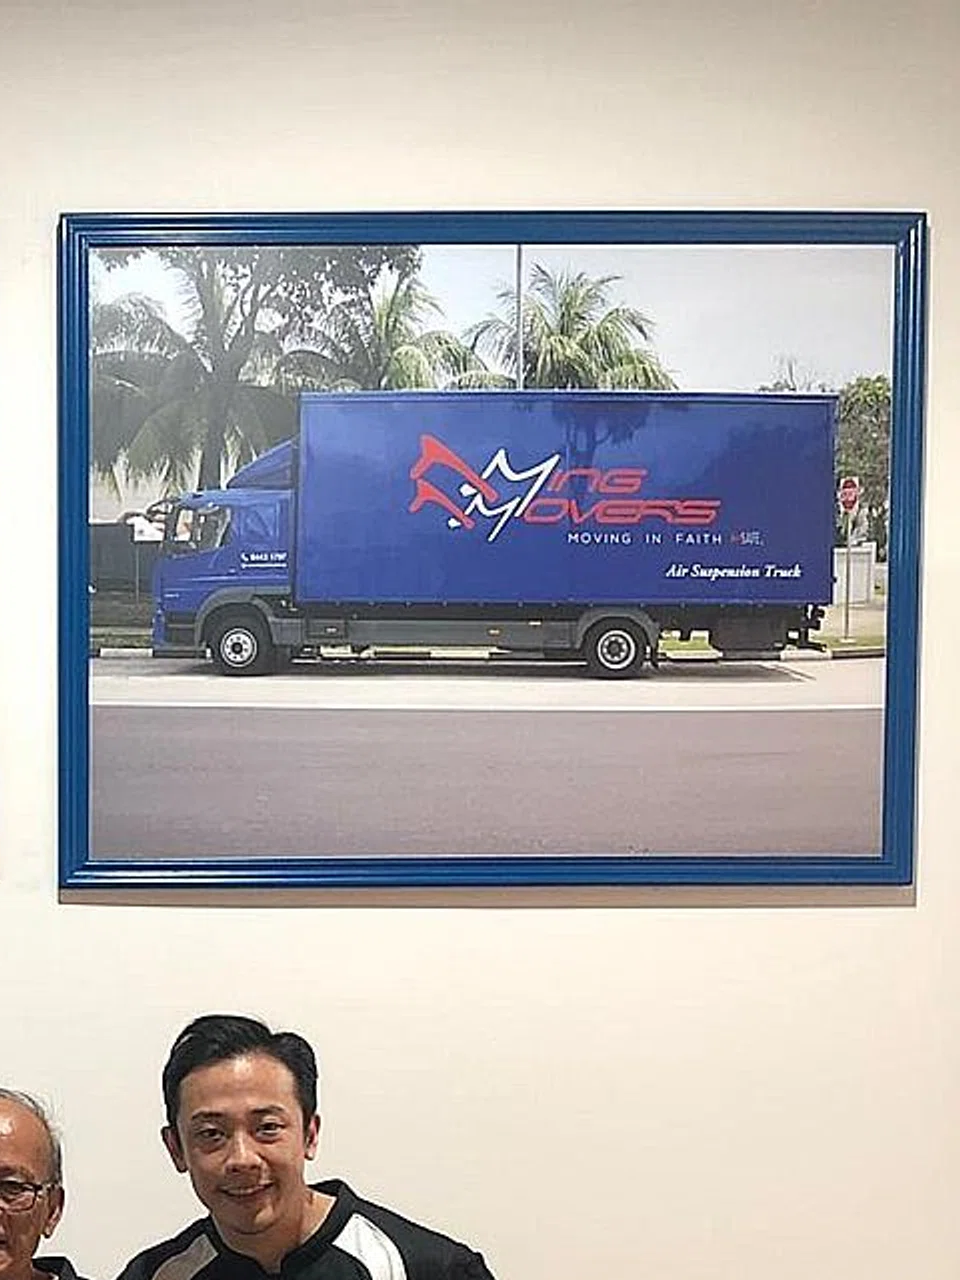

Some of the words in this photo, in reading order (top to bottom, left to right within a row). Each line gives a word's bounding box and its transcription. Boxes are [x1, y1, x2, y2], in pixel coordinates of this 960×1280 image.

[567, 532, 632, 545] MOVING
[645, 532, 662, 545] IN
[675, 532, 722, 545] FAITH
[666, 563, 689, 578] Air
[690, 563, 760, 582] Suspension
[763, 563, 802, 578] Truck
